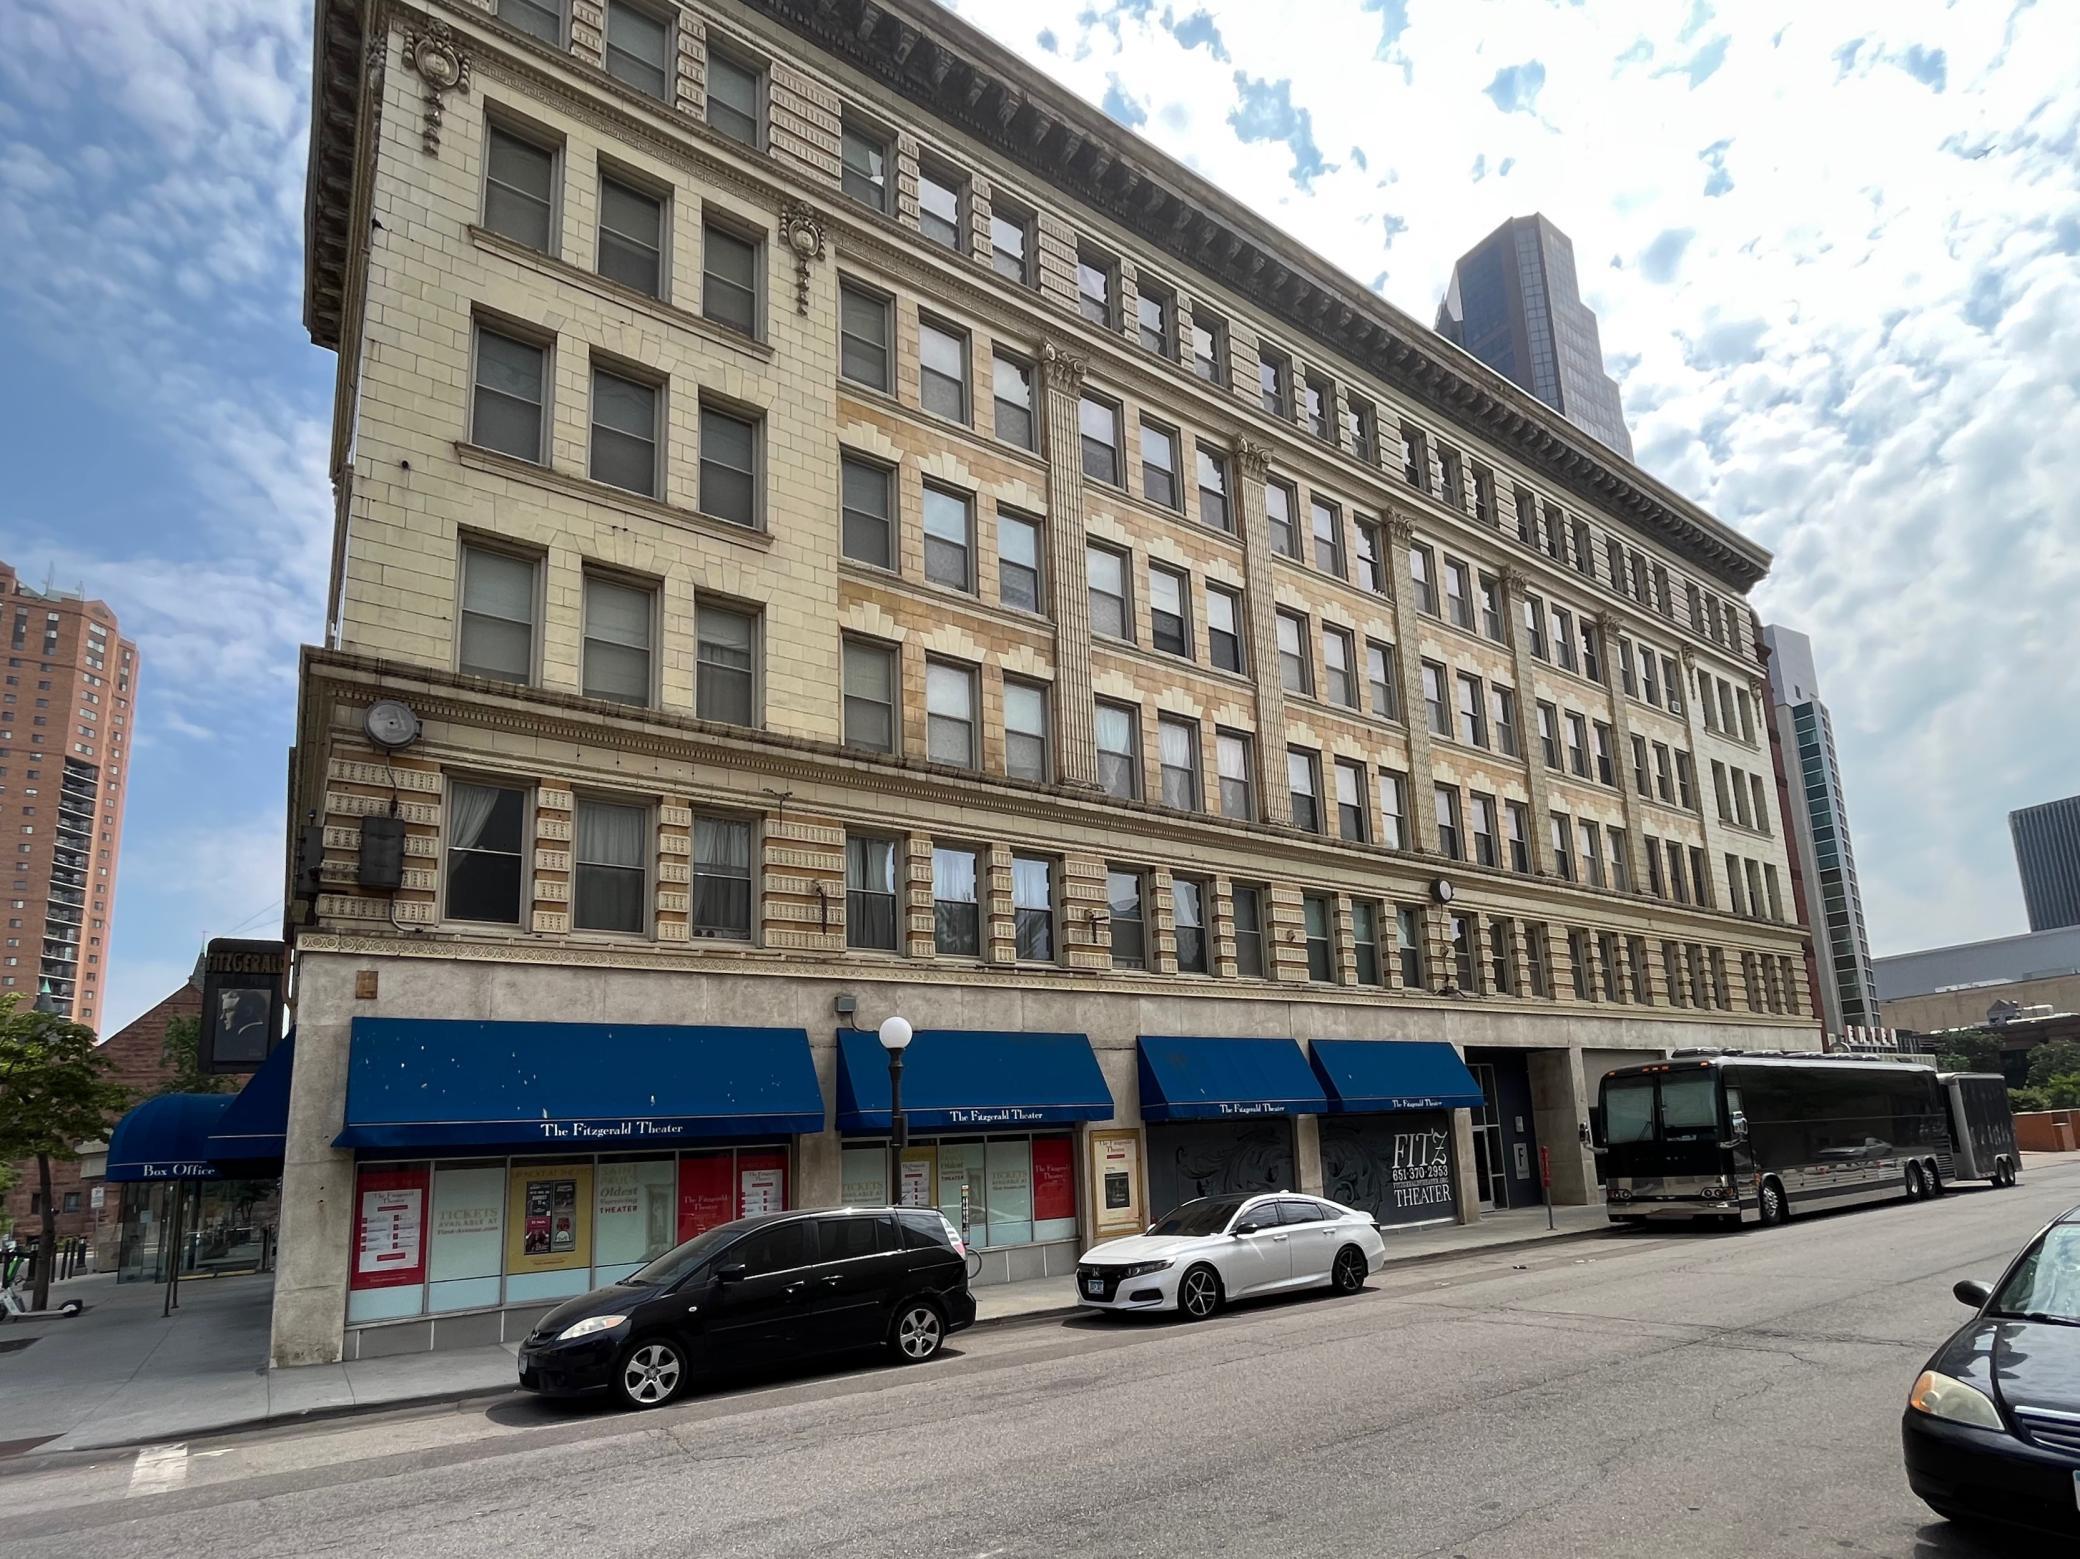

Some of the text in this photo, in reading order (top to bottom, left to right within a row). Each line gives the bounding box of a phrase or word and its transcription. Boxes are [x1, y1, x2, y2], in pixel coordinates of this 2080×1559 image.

[1219, 1103, 1232, 1113] The
[1234, 1103, 1261, 1114] Fitzgerald
[949, 1109, 1043, 1122] The Fitzgerald Theater
[540, 1121, 684, 1138] The Fitzgerald Theater
[1391, 1128, 1448, 1169] FITZ
[143, 1164, 215, 1176] Box Office
[600, 1187, 638, 1198] Oldest
[1394, 1183, 1452, 1207] THEATER
[440, 1208, 498, 1220] TICKETS
[600, 1205, 638, 1214] THEATER
